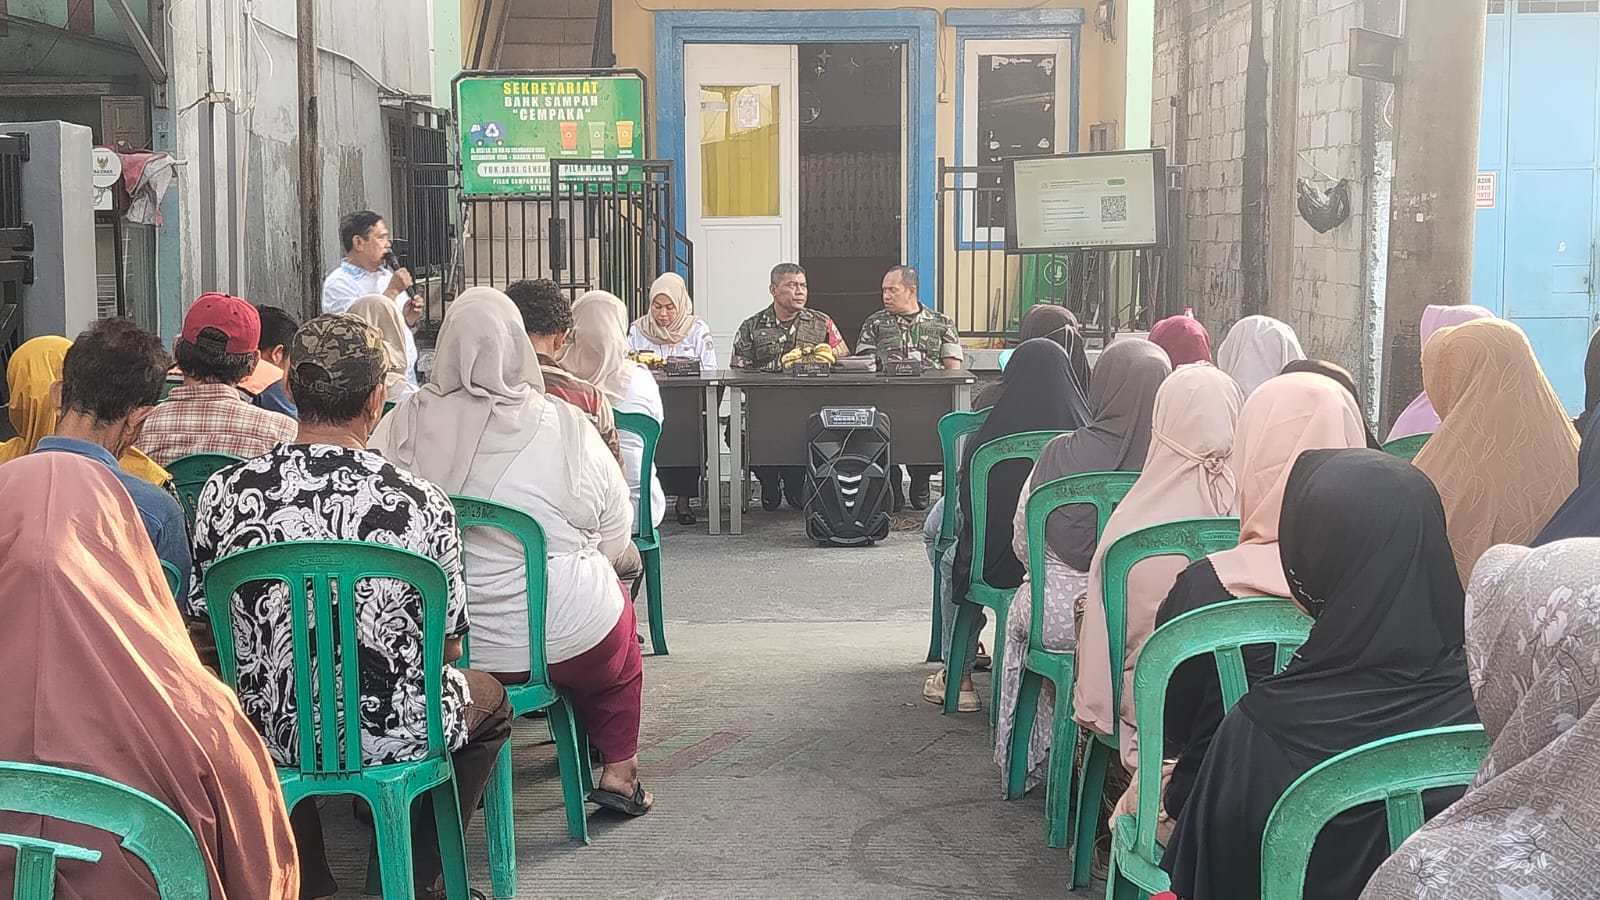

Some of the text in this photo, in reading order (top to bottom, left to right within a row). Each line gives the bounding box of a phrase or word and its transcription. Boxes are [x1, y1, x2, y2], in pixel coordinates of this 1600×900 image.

[503, 81, 598, 95] SEKRETARIAT
[504, 95, 598, 107] BANK SAMPAH
